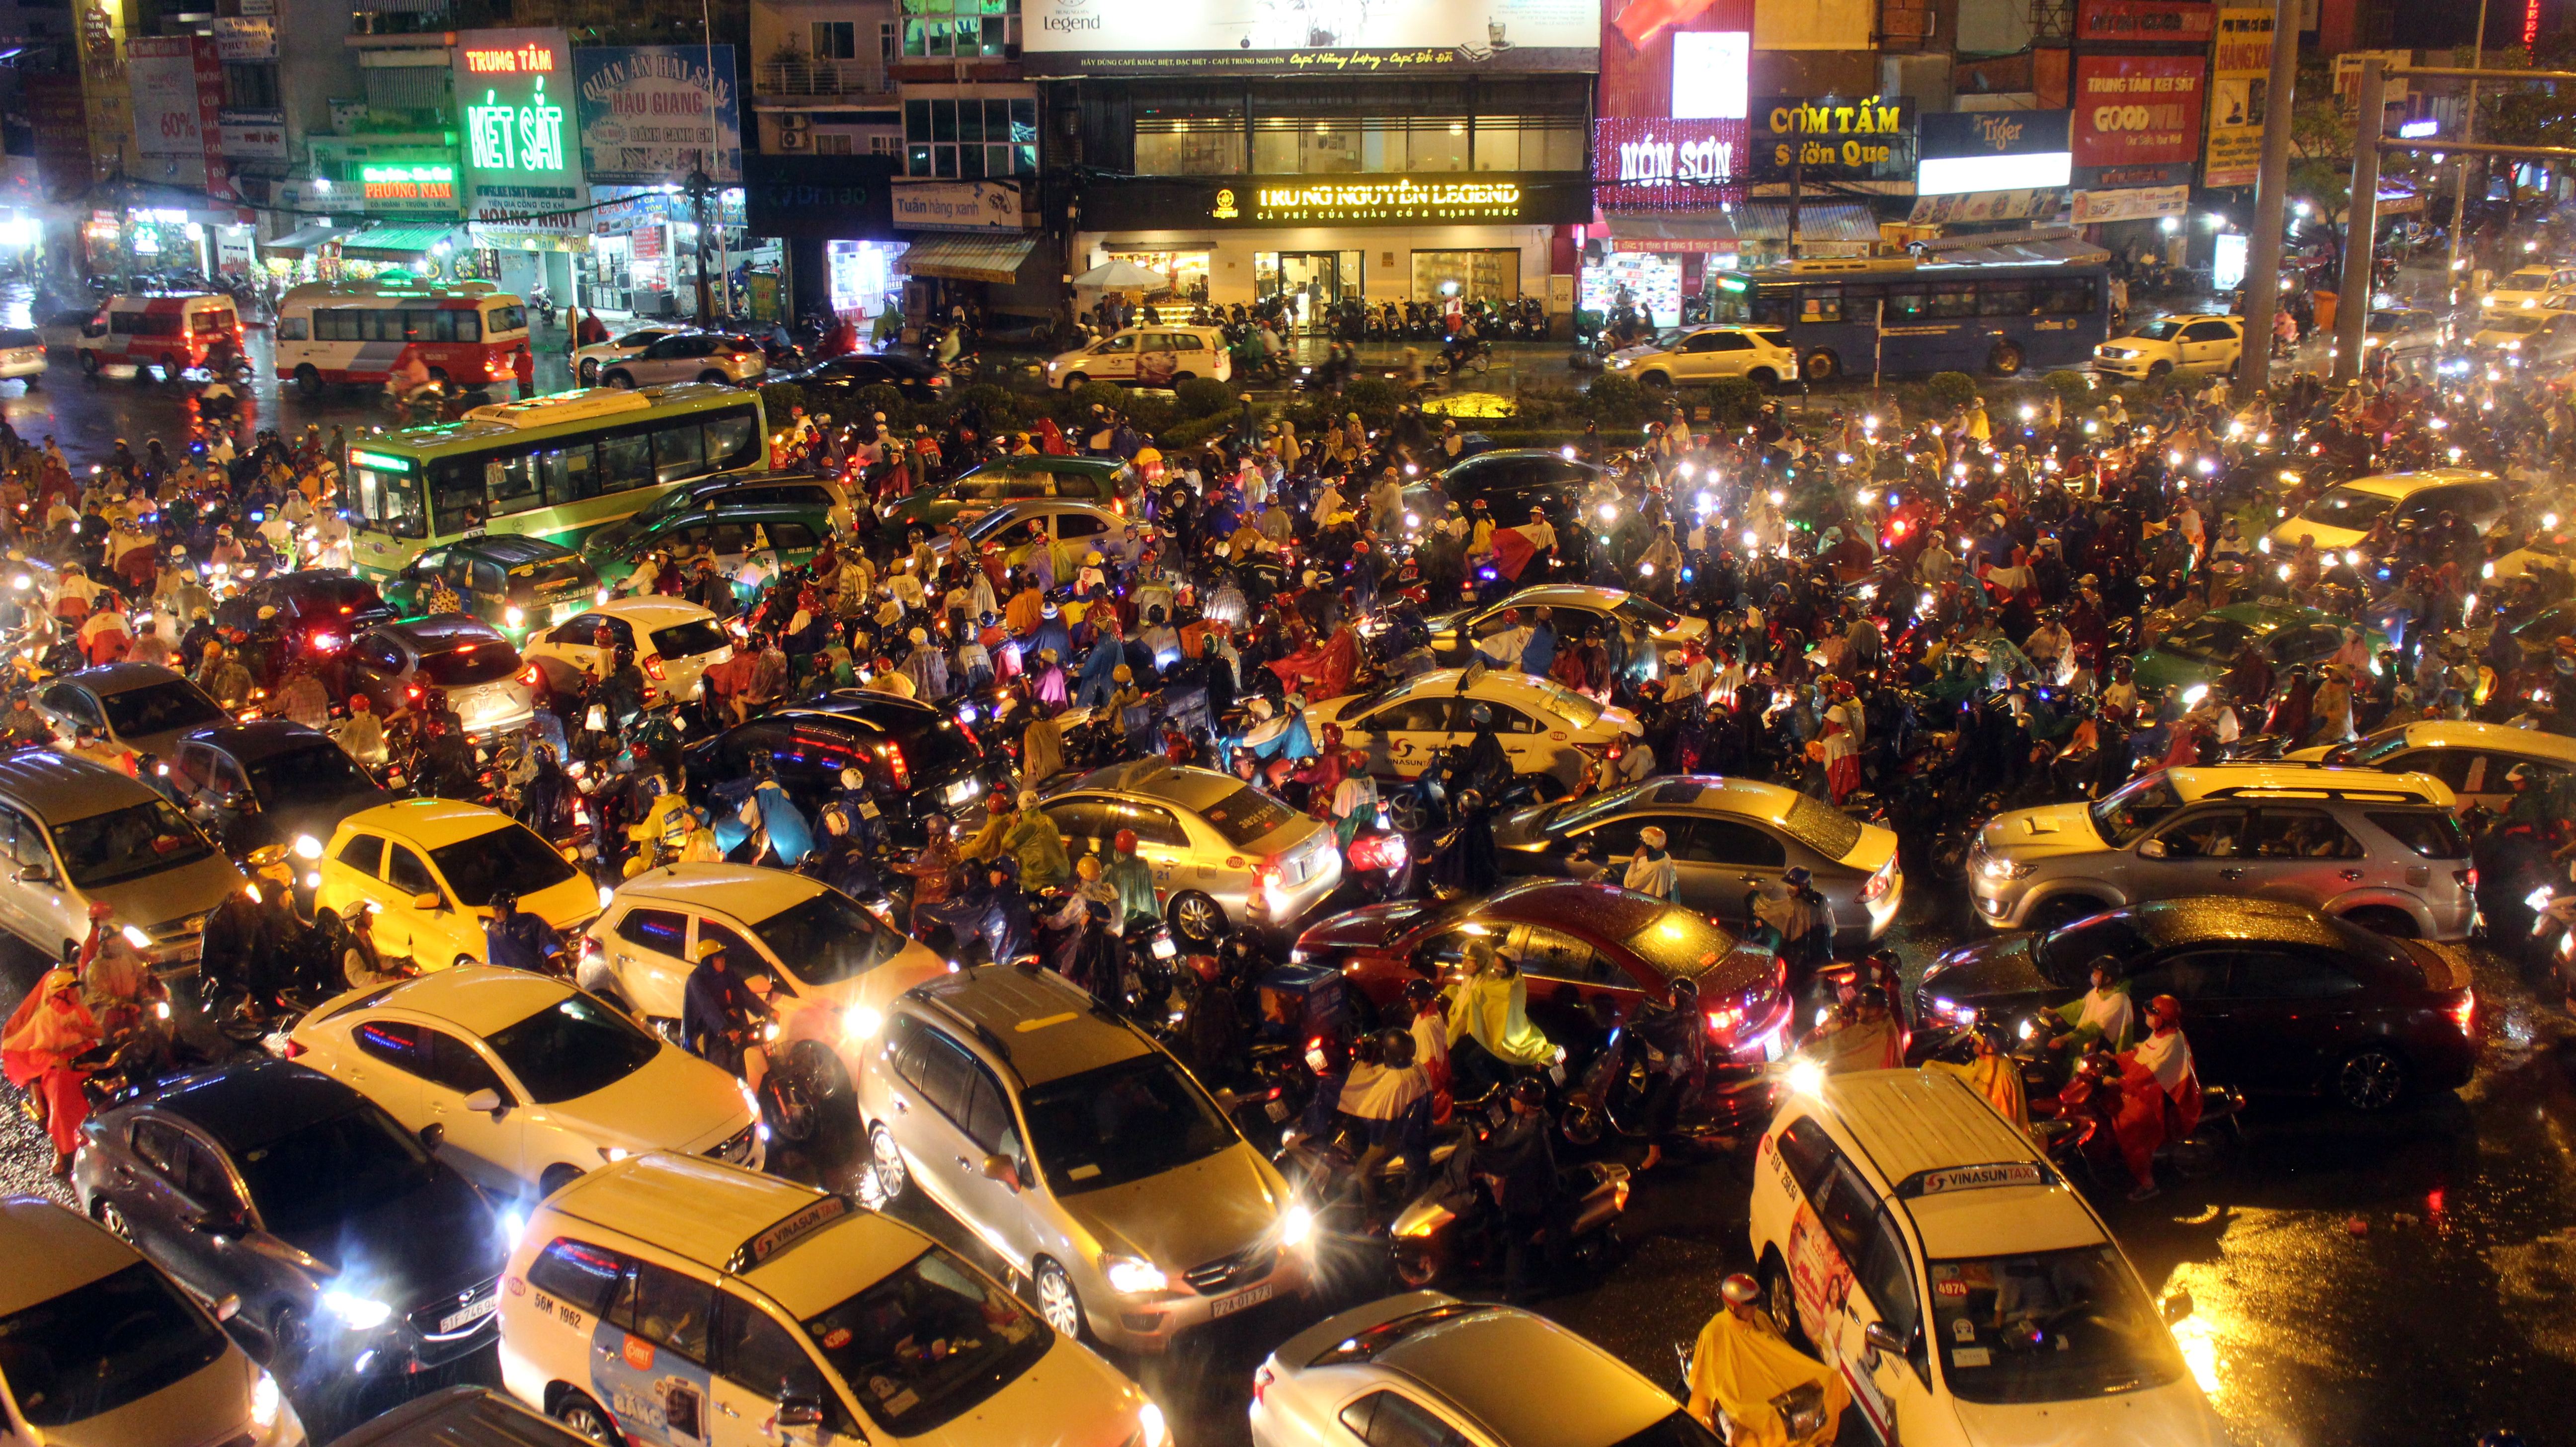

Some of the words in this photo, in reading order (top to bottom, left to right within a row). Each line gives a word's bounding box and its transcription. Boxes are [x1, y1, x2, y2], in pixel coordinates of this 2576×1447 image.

[1044, 14, 1100, 33] Legend
[467, 51, 516, 72] TRUNG
[518, 44, 553, 71] TÂM
[1316, 52, 1348, 70] Năng
[1350, 51, 1381, 71] Lượng
[582, 61, 626, 101] QUÁN
[630, 53, 653, 79] ĂN
[656, 52, 689, 81] HẢI
[2088, 77, 2126, 94] TRUNG
[2127, 71, 2152, 93] TÂM
[610, 88, 646, 121] HẬU
[650, 91, 704, 116] GIANG
[1770, 101, 1831, 134] CƠM
[1835, 94, 1901, 134] TẤM
[161, 112, 196, 138] 60%
[468, 89, 514, 169] KÉT
[520, 75, 563, 171] SẮT
[2093, 103, 2185, 133] GOODWILL
[662, 127, 694, 143] CANH
[1983, 116, 2023, 151] Tiger
[1620, 133, 1675, 187] NÓN
[1678, 135, 1732, 188] SƠN
[1842, 140, 1890, 167] Que
[364, 181, 418, 198] PHƯƠNG
[419, 182, 452, 198] NAM
[1260, 185, 1333, 206] TRUNG
[1335, 179, 1429, 206] NGUYÊN
[1432, 184, 1520, 204] LEGEND
[897, 197, 927, 213] Tuấn
[955, 200, 979, 216] xanh
[1257, 209, 1274, 220] CÀ
[1284, 209, 1308, 220] PHÊ
[1318, 208, 1344, 219] CỦA
[1353, 208, 1387, 219] GIÀU
[1396, 207, 1413, 218] CÓ
[1439, 209, 1475, 219] HẠNH
[1484, 206, 1519, 217] PHÚC
[558, 236, 586, 251] 30%
[1384, 758, 1423, 767] VINASUN
[1226, 858, 1244, 867] T3023
[1156, 871, 1170, 881] 21
[1949, 1169, 2008, 1185] VINASUN
[2008, 1168, 2035, 1180] TAXI
[774, 1209, 821, 1243] VINASUN
[821, 1200, 842, 1219] TAXI
[1938, 1283, 1968, 1294] 4974
[534, 1293, 554, 1315] 56M
[560, 1306, 582, 1330] 1962
